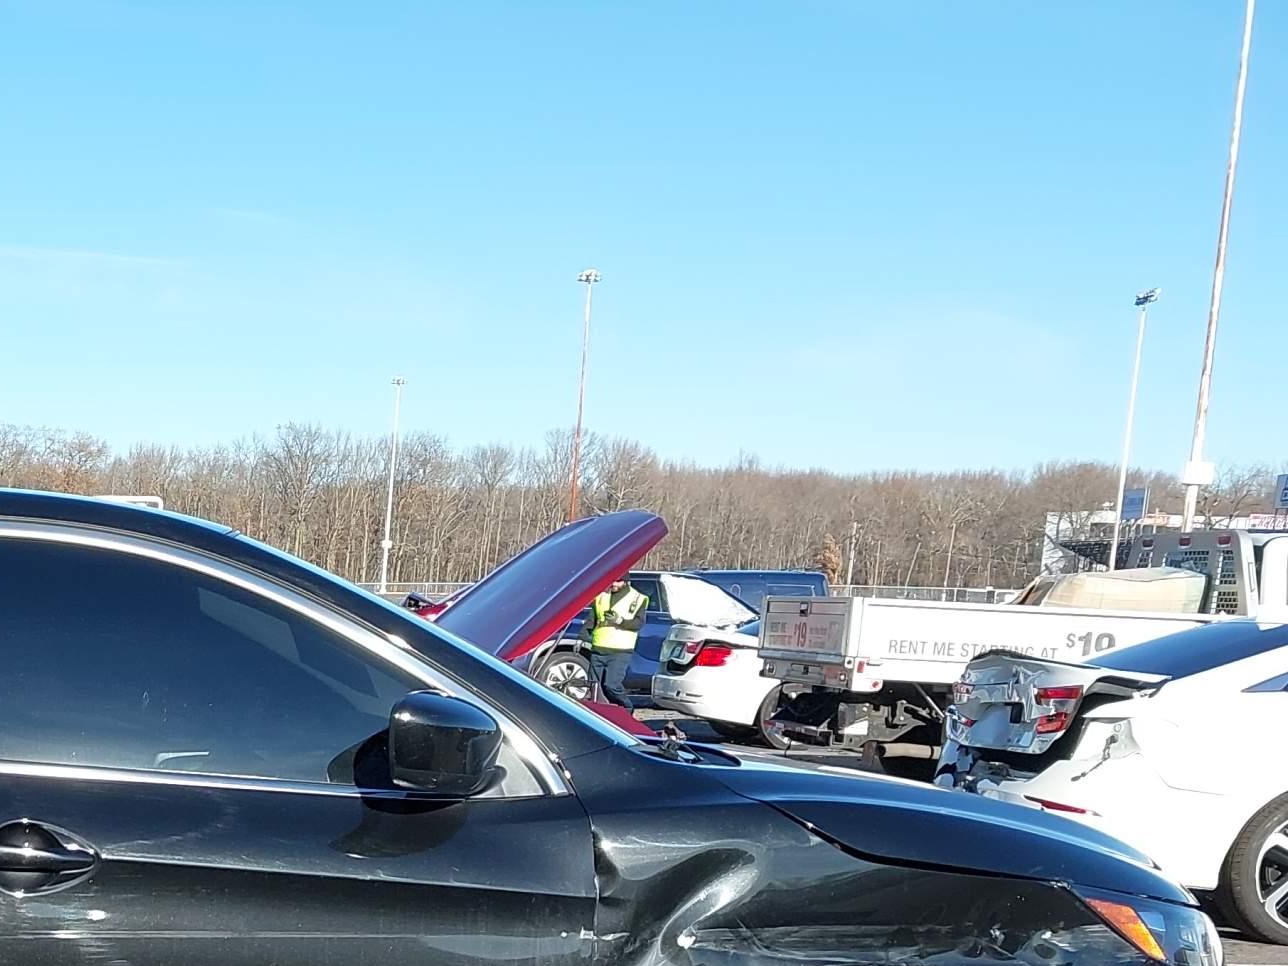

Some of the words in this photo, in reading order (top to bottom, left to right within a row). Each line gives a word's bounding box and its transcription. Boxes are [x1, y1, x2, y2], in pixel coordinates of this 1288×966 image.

[888, 639, 929, 655] RENT
[932, 641, 956, 657] ME
[1040, 647, 1059, 659] AT
